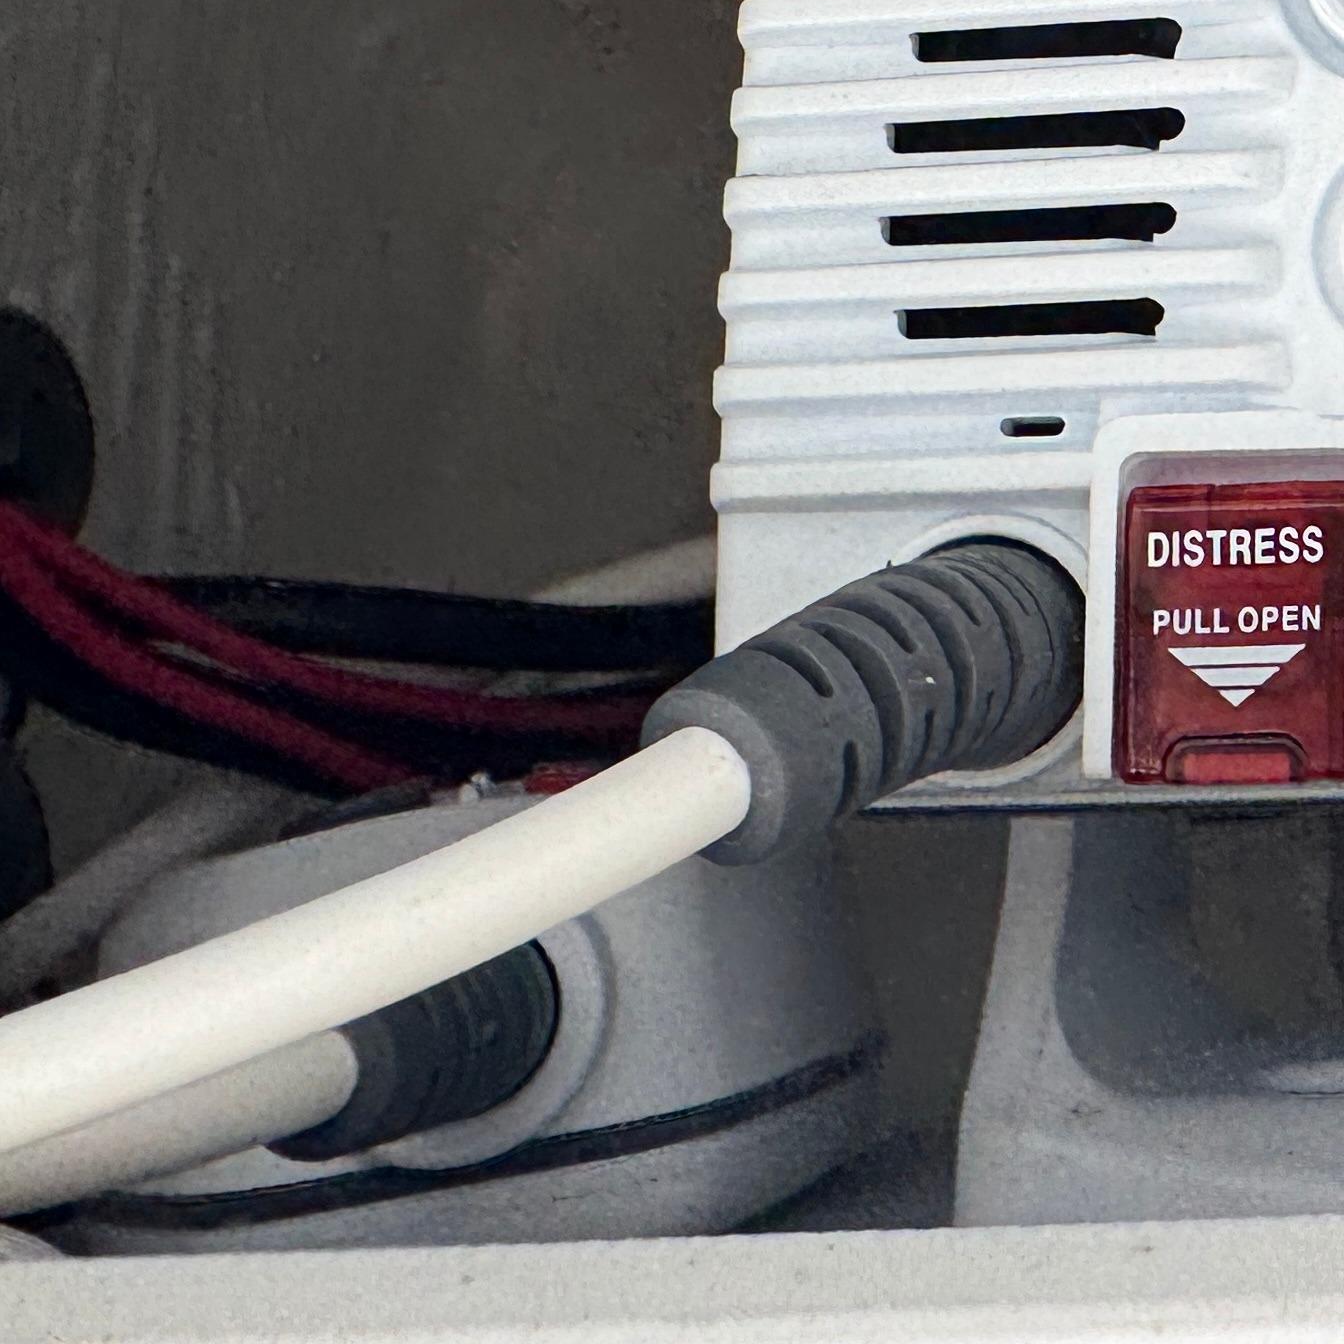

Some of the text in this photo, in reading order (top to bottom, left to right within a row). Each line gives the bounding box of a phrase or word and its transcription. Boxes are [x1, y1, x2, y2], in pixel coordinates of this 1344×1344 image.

[1146, 524, 1325, 568] DISTRESS
[1152, 604, 1322, 636] PULL OPEN
